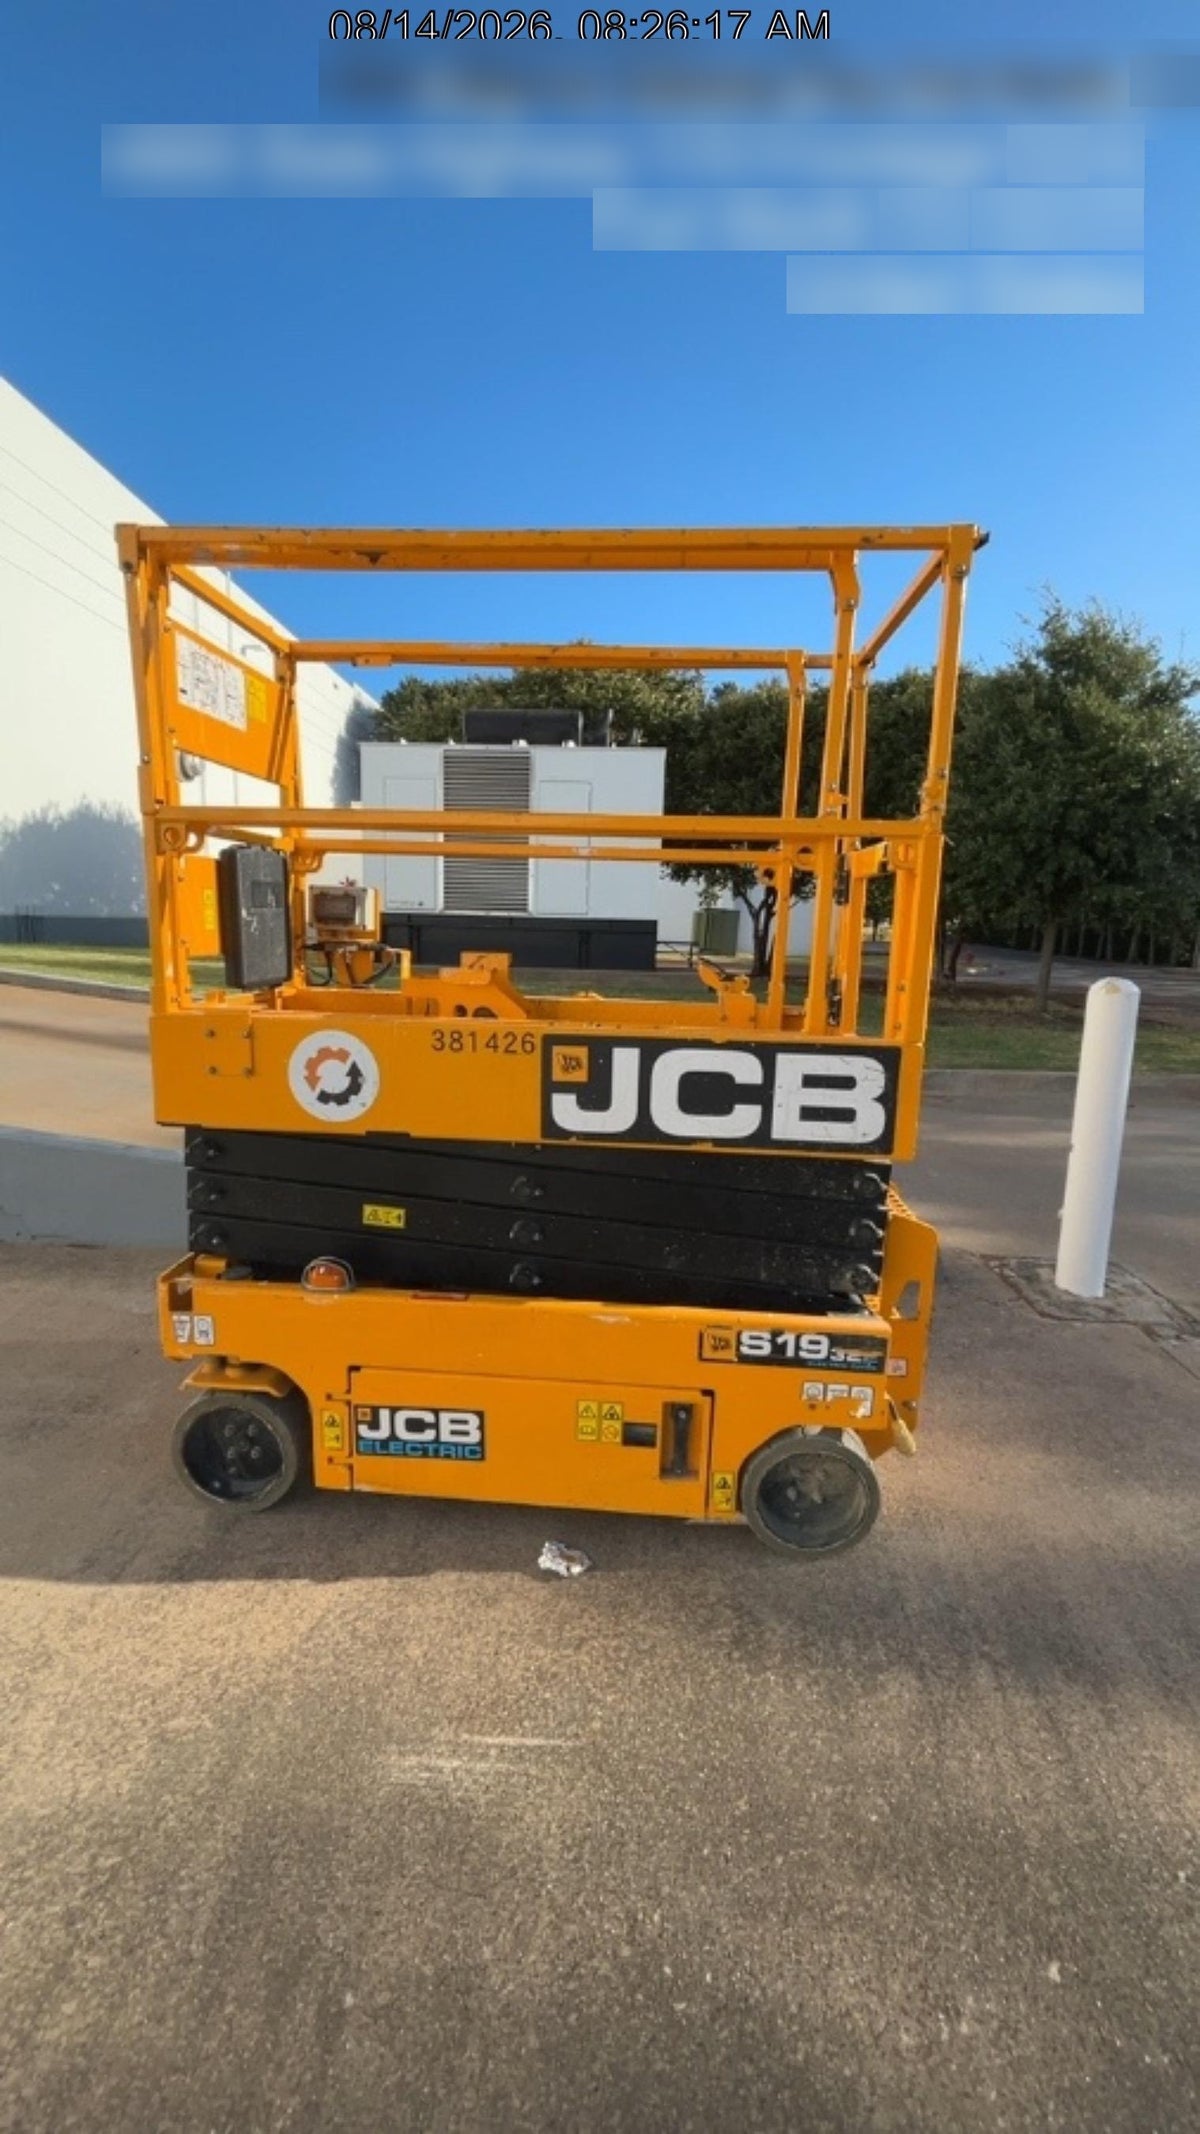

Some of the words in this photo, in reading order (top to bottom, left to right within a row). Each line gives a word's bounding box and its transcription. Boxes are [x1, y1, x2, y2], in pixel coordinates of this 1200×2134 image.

[431, 1029, 536, 1054] 381426
[551, 1047, 886, 1144] JCB
[357, 1408, 482, 1444] JCB
[358, 1440, 482, 1459] ELECTRIC
